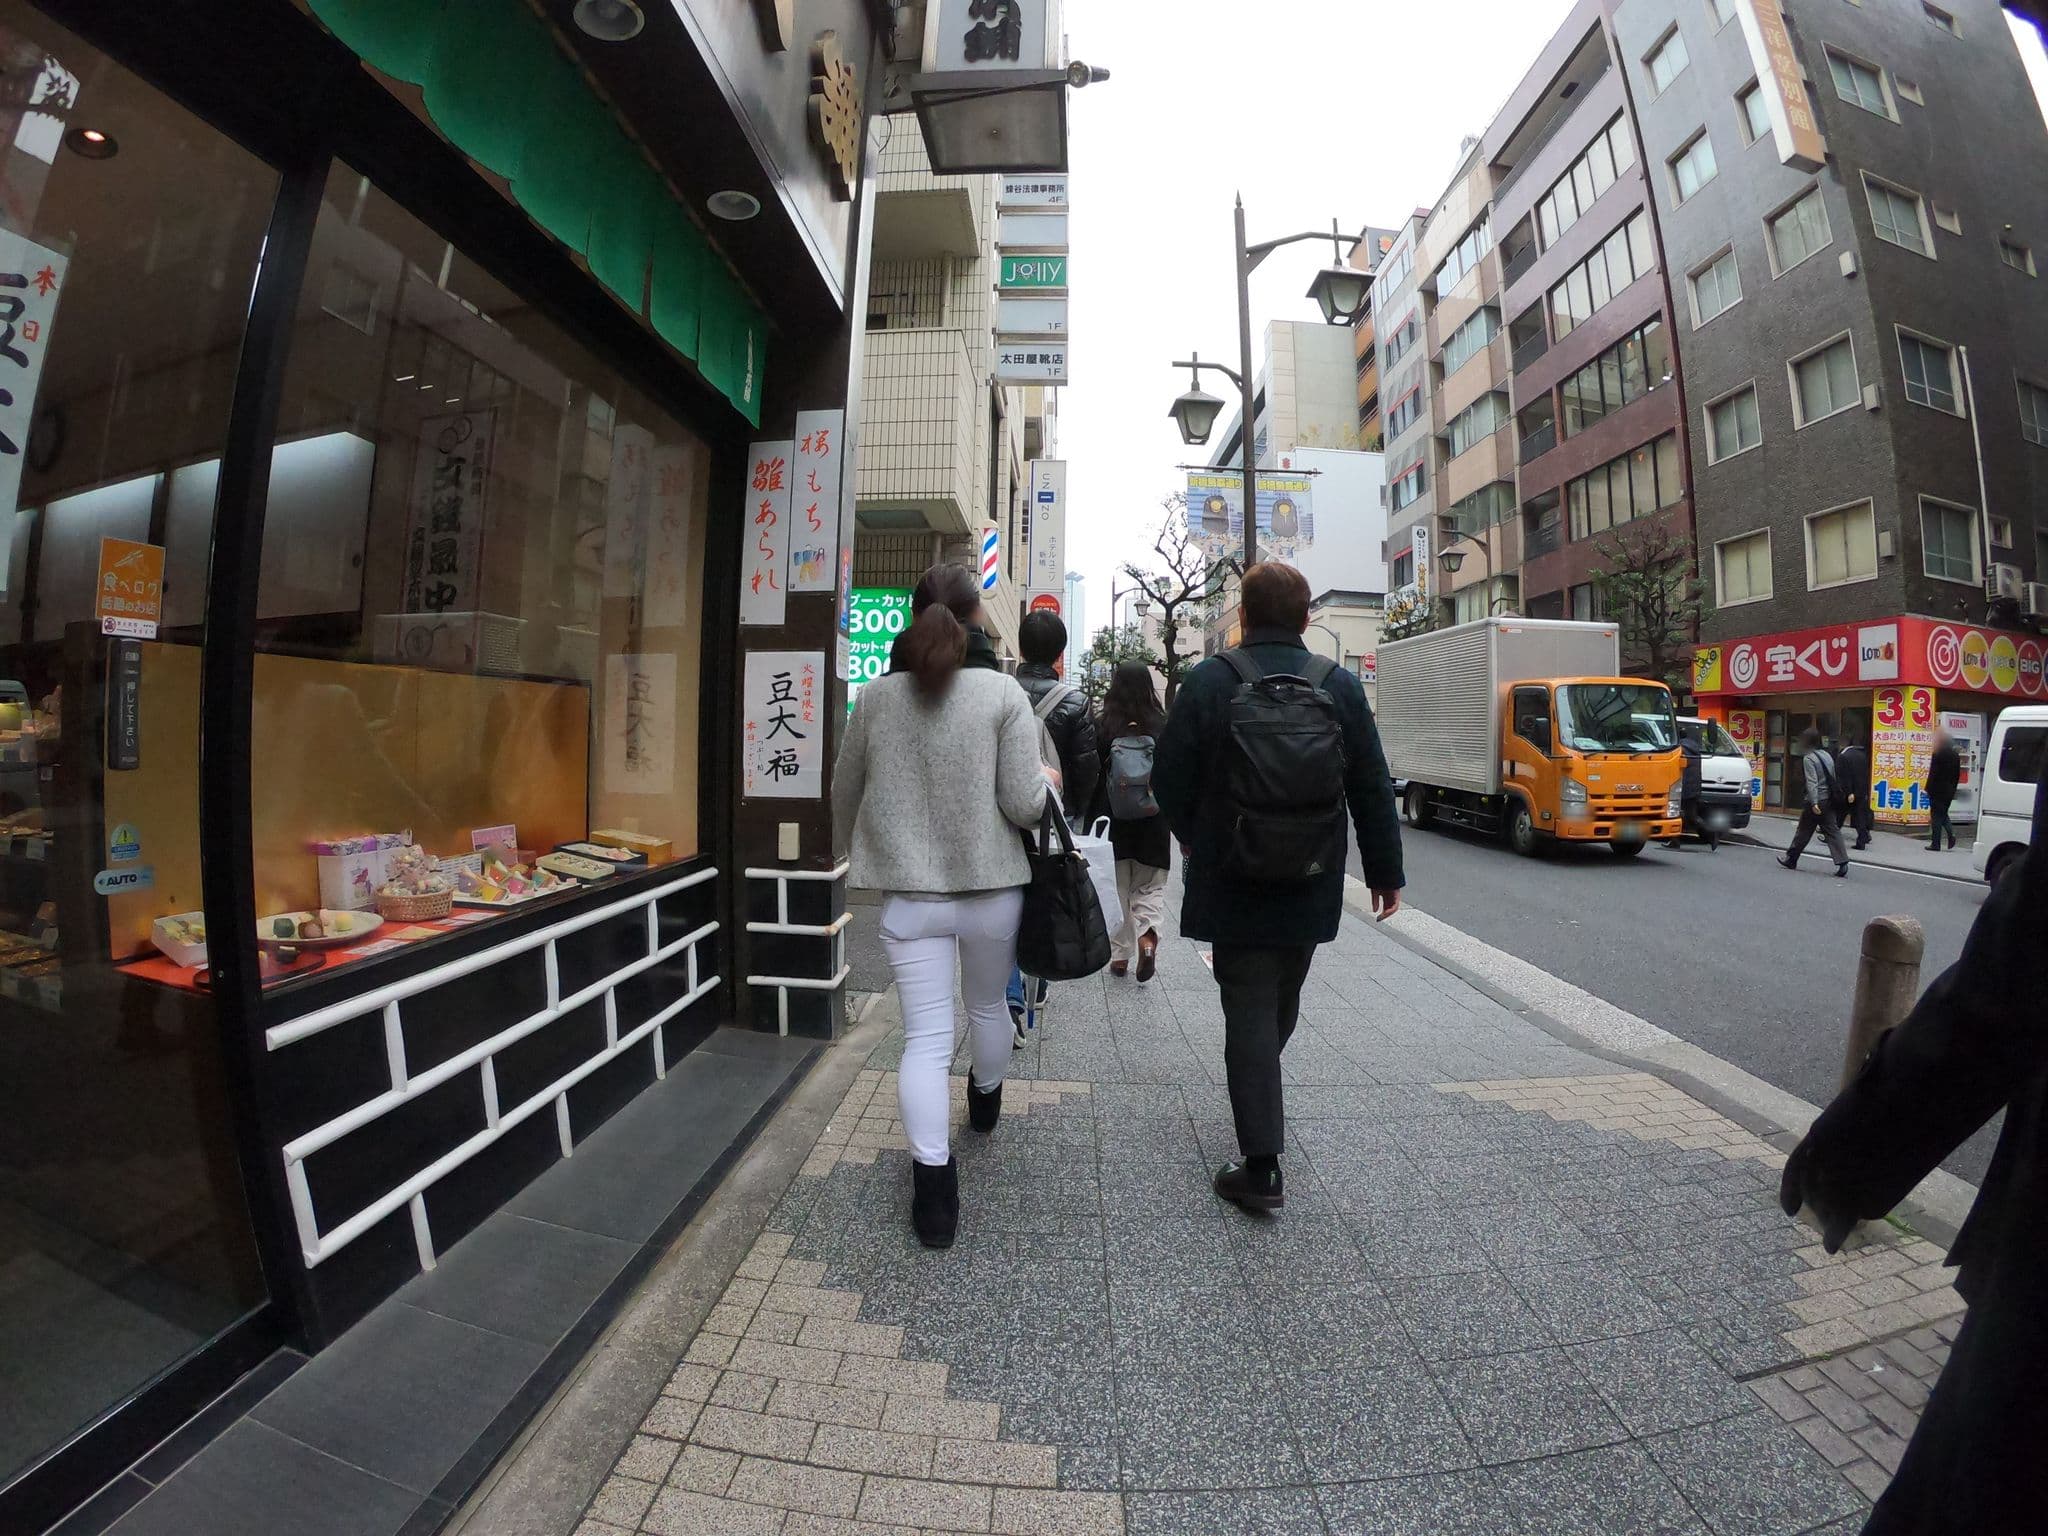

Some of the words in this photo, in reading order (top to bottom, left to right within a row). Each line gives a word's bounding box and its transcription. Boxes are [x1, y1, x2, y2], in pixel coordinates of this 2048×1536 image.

[1048, 322, 1062, 330] 1F
[1001, 353, 1063, 364] 太田屋靴店
[1047, 367, 1061, 376] 1F
[800, 428, 830, 533] 桜もち
[1038, 473, 1054, 521] UNIZO
[751, 456, 786, 595] 雛あられ
[1765, 636, 1848, 682] 宝くじ
[801, 663, 815, 723] 火曜日限定
[1877, 688, 1905, 726] 3
[1911, 689, 1931, 726] 3
[764, 671, 807, 783] 豆大福
[1730, 712, 1751, 741] 3
[1948, 719, 1968, 729] KIRIN
[1876, 752, 1905, 769] 年末
[1873, 779, 1905, 809] 1等
[106, 873, 138, 887] AUTO
